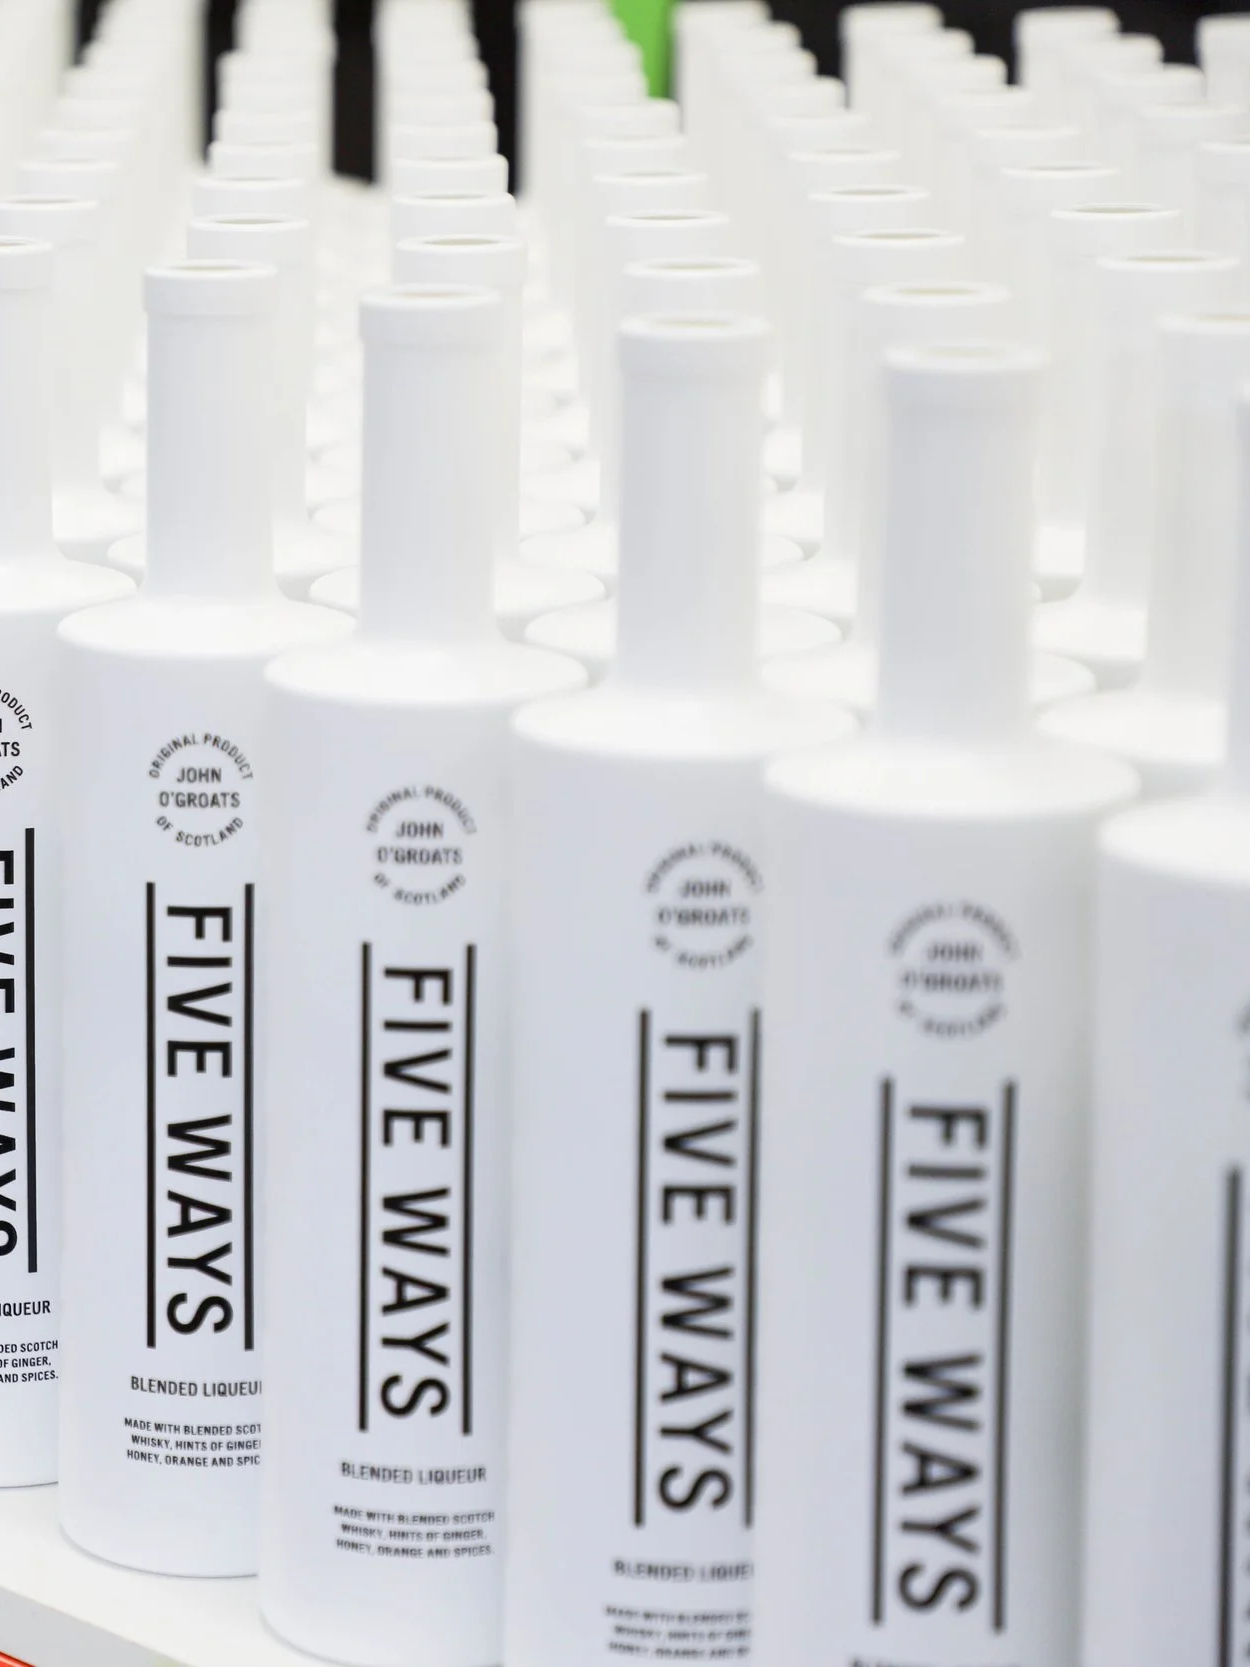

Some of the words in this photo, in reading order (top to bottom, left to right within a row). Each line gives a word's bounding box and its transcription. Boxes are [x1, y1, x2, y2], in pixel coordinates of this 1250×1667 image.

[149, 733, 199, 779] ORIGINAL
[203, 733, 254, 780] PRODUCT
[176, 767, 222, 783] JOHN
[159, 791, 240, 808] O'GROATS
[156, 815, 174, 831] OF
[176, 816, 244, 847] SCOTLAND
[395, 820, 444, 838] JOHN
[377, 845, 463, 865] O'GROATS
[166, 905, 233, 1079] FIVE
[382, 967, 454, 1149] FIVE
[661, 1034, 738, 1225] FIVE
[903, 1105, 990, 1309] FIVE
[166, 1113, 234, 1335] WAYS
[380, 1186, 451, 1419] WAYS
[20, 1339, 59, 1352] SCOTCH
[11, 1355, 52, 1367] GINGER,
[21, 1369, 59, 1383] SPICES.
[131, 1376, 198, 1396] BLENDED
[658, 1265, 736, 1513] WAYS
[124, 1417, 152, 1432] MADE
[154, 1422, 181, 1434] WITH
[184, 1424, 233, 1436] BLENDED
[235, 1424, 262, 1435] SCOT
[131, 1434, 173, 1451] WHISKY,
[175, 1440, 207, 1451] HINTS
[210, 1441, 224, 1452] OF
[226, 1439, 261, 1451] GINGE
[165, 1455, 209, 1467] ORANGE
[211, 1456, 234, 1467] AND
[236, 1455, 261, 1466] SPIC
[341, 1461, 414, 1484] BLENDED
[417, 1466, 487, 1486] LIQUEUR
[896, 1351, 985, 1614] WAYS
[452, 1511, 495, 1525] SCOTCH
